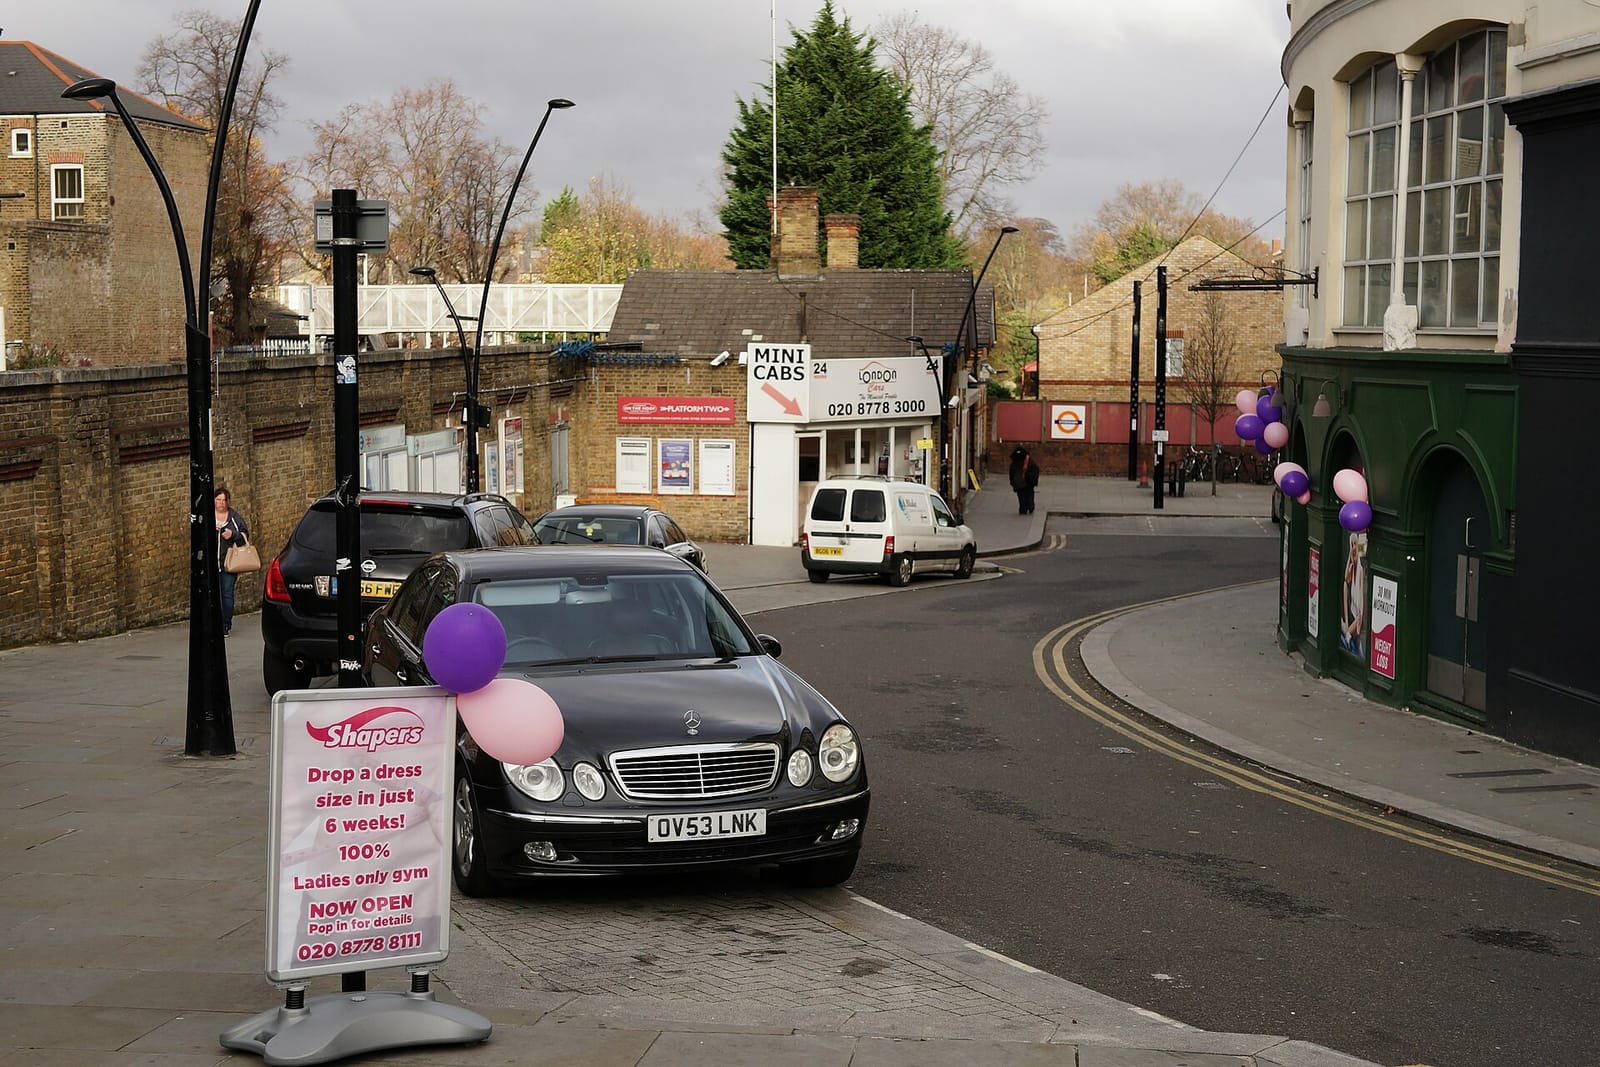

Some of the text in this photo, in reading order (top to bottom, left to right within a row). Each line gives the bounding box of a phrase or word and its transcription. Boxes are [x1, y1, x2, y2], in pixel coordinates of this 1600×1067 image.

[755, 348, 804, 364] MINI
[753, 365, 805, 381] CABS
[814, 363, 827, 374] 24
[667, 405, 724, 413] PLATFORM TWO
[828, 399, 926, 416] 020 8778 3000
[1374, 599, 1395, 616] WORKOUTS
[1375, 637, 1392, 655] WEIGHT
[1376, 653, 1388, 670] LOSS
[324, 723, 424, 752] Shapers
[308, 764, 422, 784] Drop a dress
[316, 789, 414, 807] size in just
[325, 814, 405, 833] 6 weeks!
[658, 812, 757, 837] OV53 LNK
[339, 843, 390, 860] 100%
[294, 867, 428, 890] Ladies only gym
[310, 894, 413, 918] NOW OPEN
[309, 914, 412, 934] Pop in for details
[298, 932, 421, 960] 020 8778 8111
